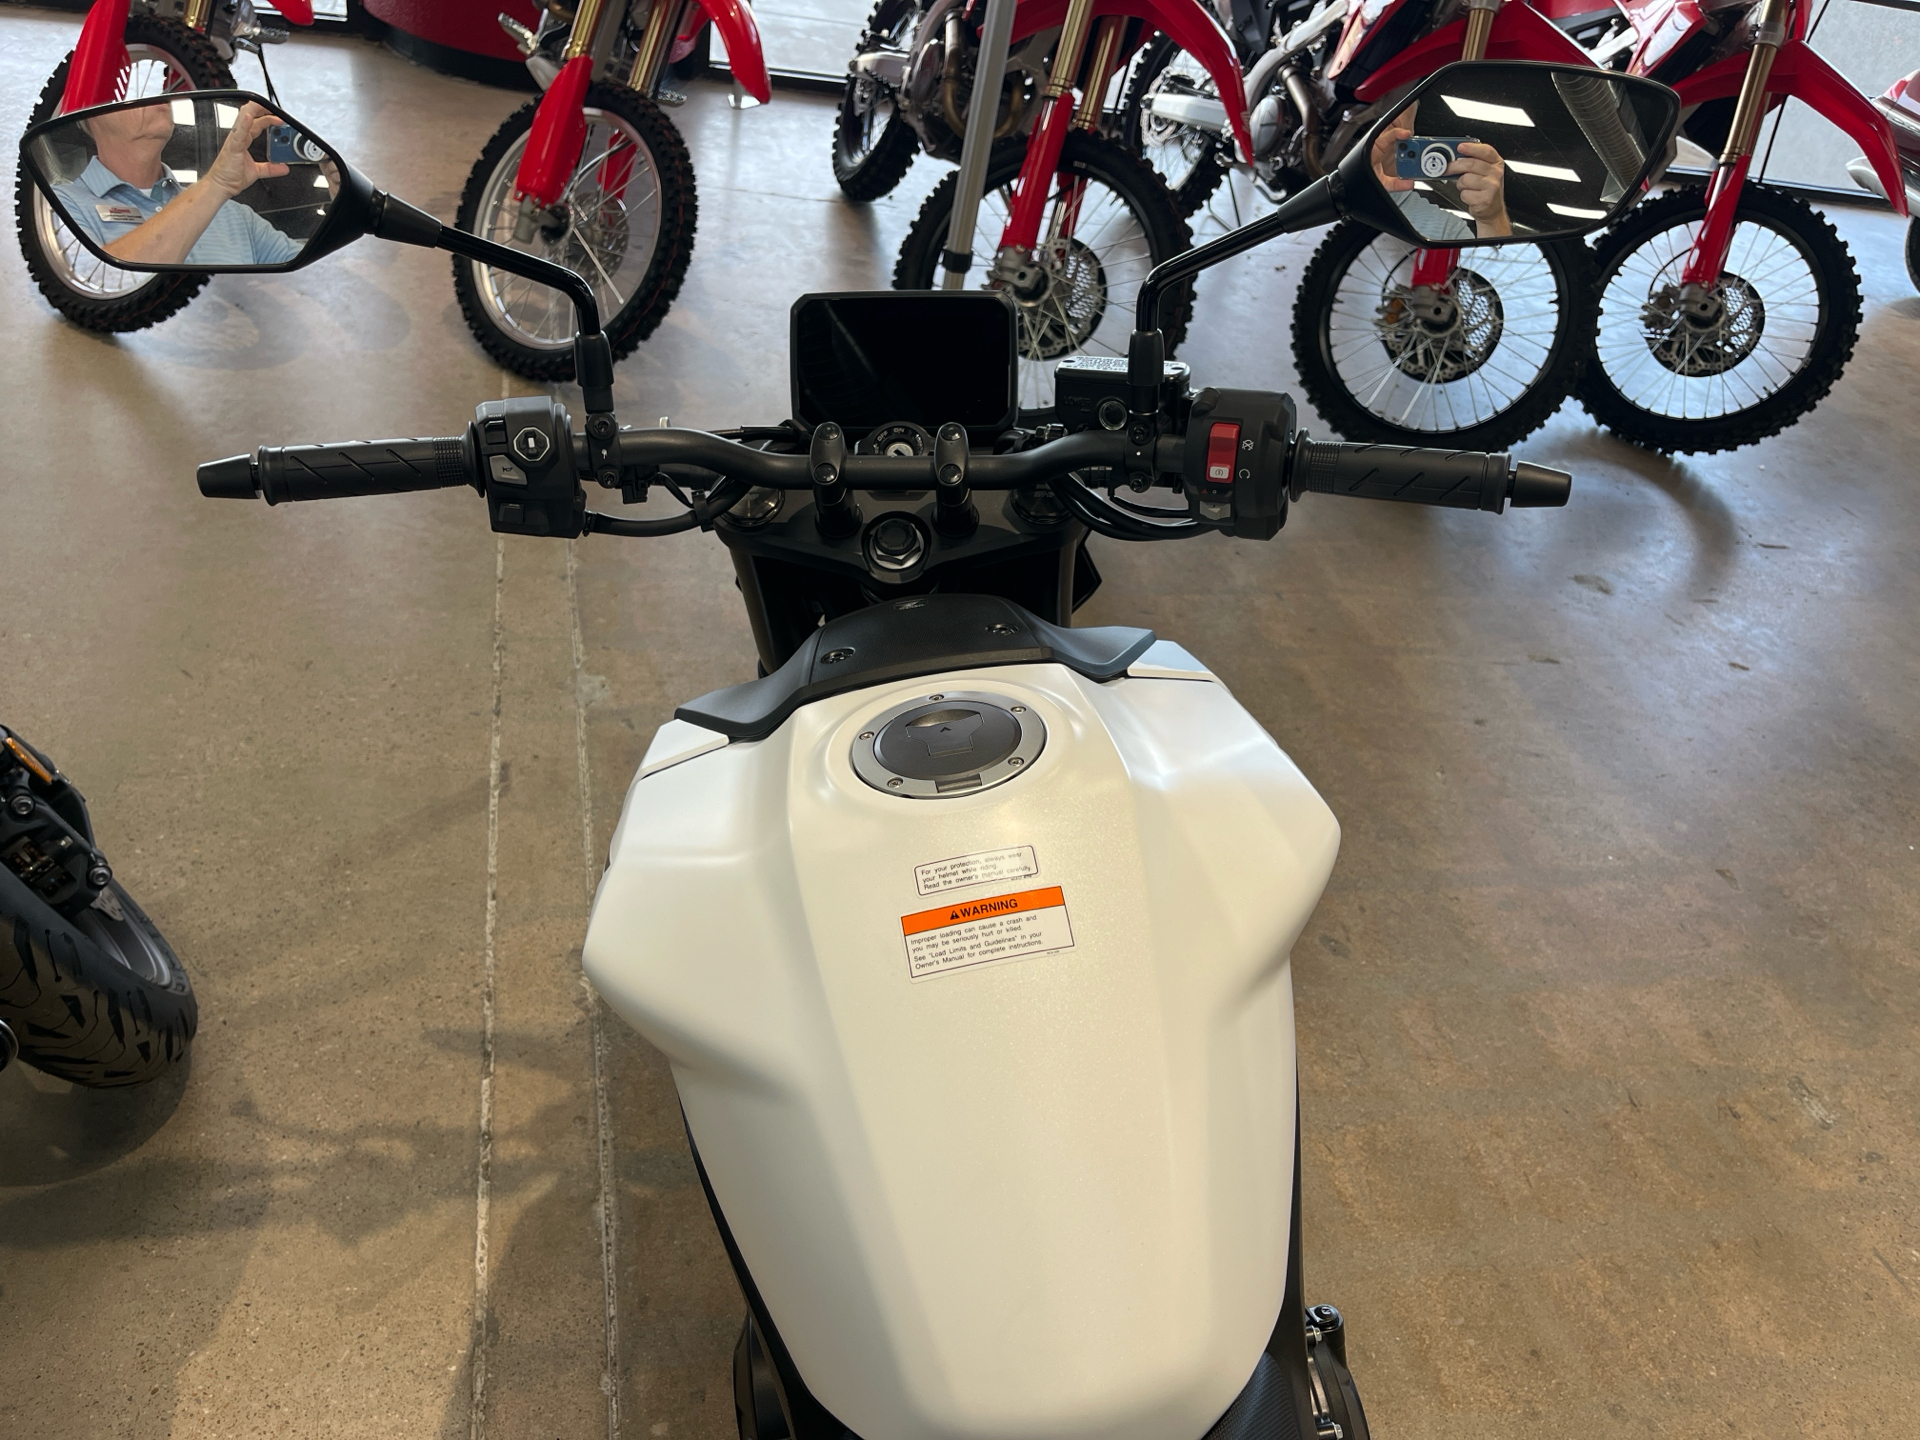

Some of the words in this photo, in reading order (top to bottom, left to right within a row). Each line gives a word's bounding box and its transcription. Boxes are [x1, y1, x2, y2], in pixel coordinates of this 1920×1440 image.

[877, 430, 889, 441] OFF
[934, 866, 947, 874] your
[950, 859, 982, 870] protection,
[984, 855, 1005, 863] always
[922, 876, 935, 884] your
[938, 870, 958, 879] helmet
[924, 882, 940, 890] Read
[955, 874, 978, 883] owner's
[982, 870, 1003, 878] manual
[960, 898, 1018, 918] WARNING
[911, 935, 937, 945] Improper
[940, 930, 961, 938] loading
[1006, 917, 1023, 925] crash
[912, 946, 923, 954] you
[926, 942, 938, 950] may
[952, 933, 978, 944] seriously
[949, 946, 967, 954] Limits
[970, 942, 981, 950] and
[984, 935, 1017, 947] Guidelines"
[1029, 931, 1042, 939] your
[915, 960, 940, 970] Owner's
[942, 954, 965, 963] Manual
[978, 946, 1006, 956] complete
[1009, 940, 1043, 950] instructions.
